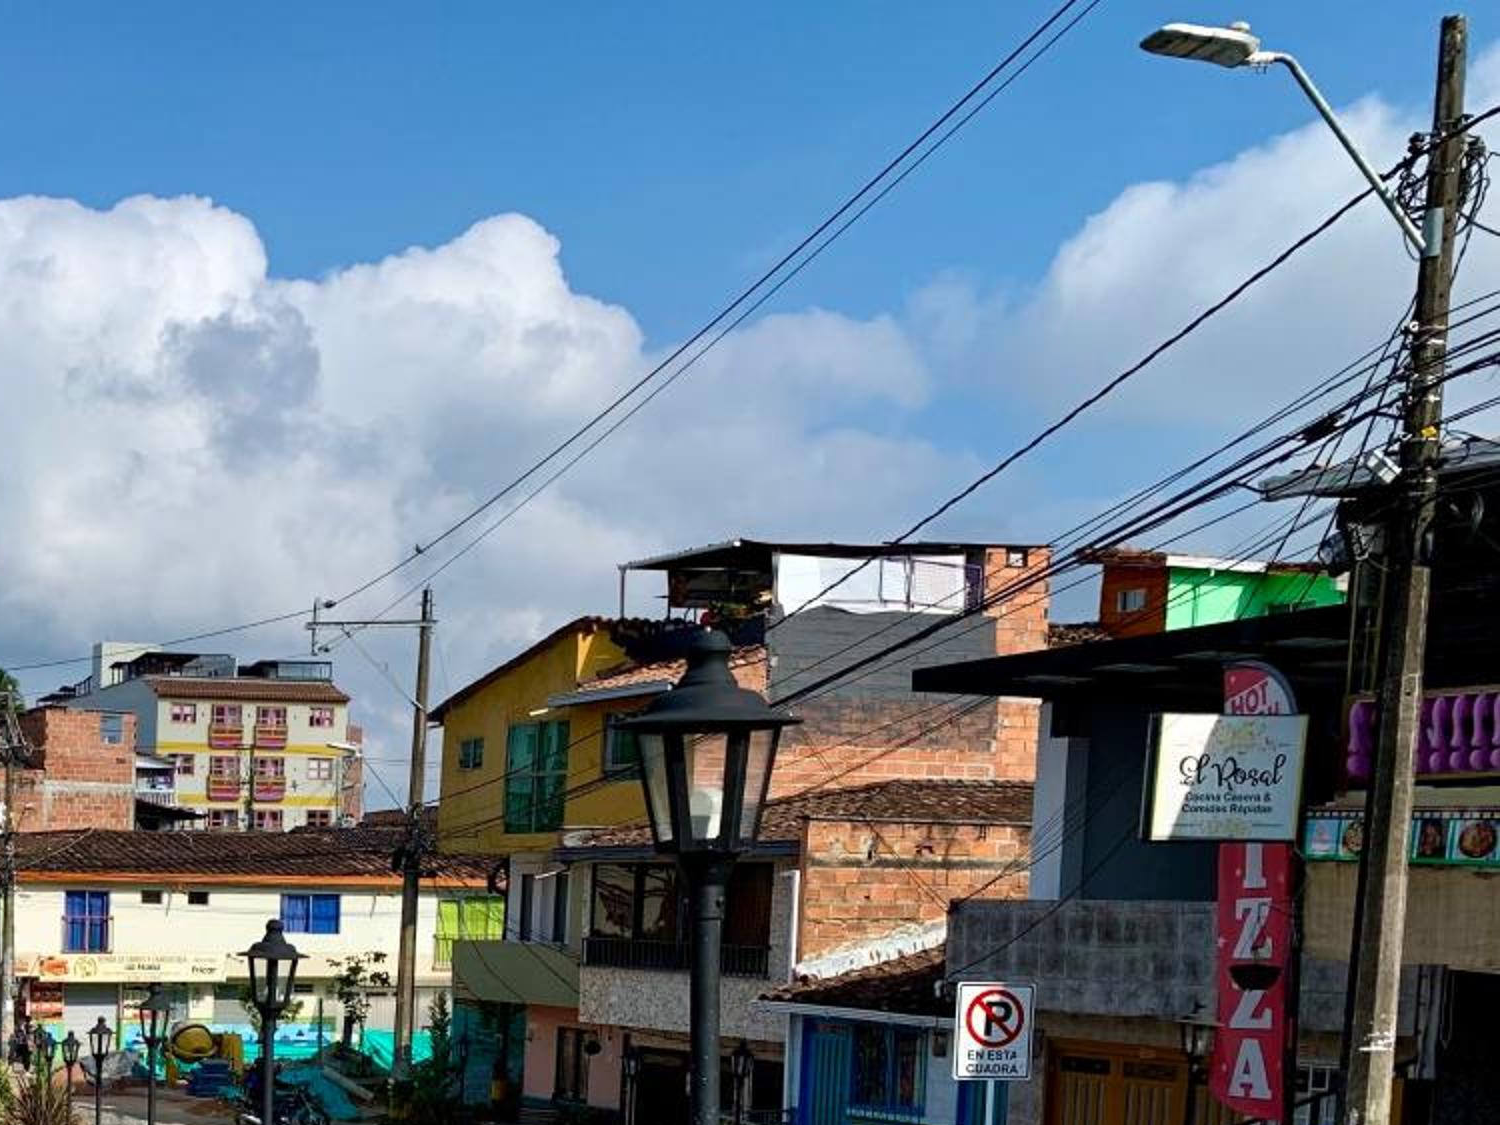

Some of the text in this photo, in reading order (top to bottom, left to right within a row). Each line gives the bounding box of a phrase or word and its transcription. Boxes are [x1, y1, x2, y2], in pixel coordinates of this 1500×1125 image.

[1231, 681, 1268, 714] HOT
[1178, 753, 1287, 791] El Rosal
[1182, 803, 1227, 813] Comidas
[1227, 843, 1272, 1099] IZZA
[967, 1049, 1017, 1061] EN ESTA
[965, 1063, 1018, 1075] CUADRA
